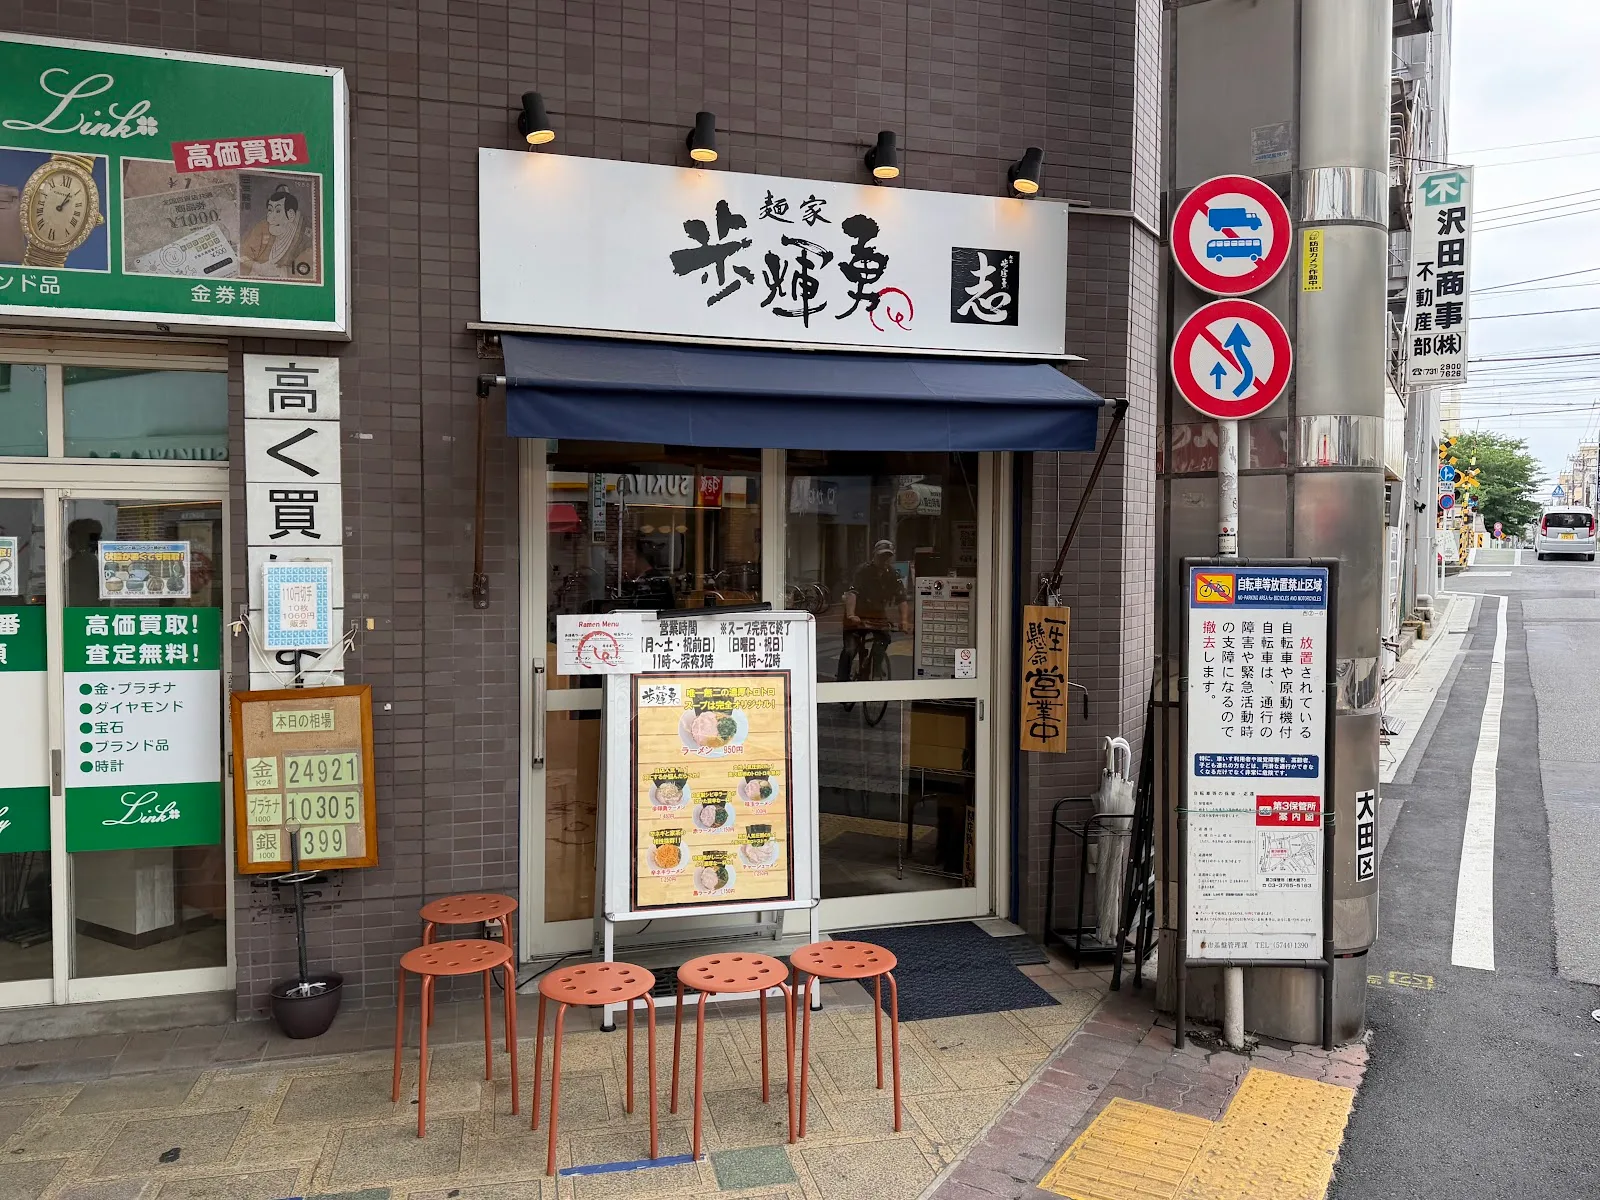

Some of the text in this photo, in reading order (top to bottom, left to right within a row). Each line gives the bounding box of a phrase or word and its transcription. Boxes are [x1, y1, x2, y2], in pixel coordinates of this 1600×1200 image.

[2, 68, 152, 139] Link
[183, 138, 297, 169] 高価買取
[758, 190, 832, 227] 麺家
[190, 284, 260, 306] 金券類
[957, 252, 1011, 323] 志
[1413, 261, 1434, 357] 不動産部
[1238, 577, 1322, 592] 自転車等放置禁止区域
[85, 614, 198, 636] 高価買取!
[602, 620, 620, 628] Menu
[660, 620, 698, 636] 営業時間
[86, 643, 199, 665] 査定無料!
[1202, 620, 1217, 700] 撤去します。
[94, 682, 176, 695] 金・プラチナ
[1221, 621, 1235, 738] の支障になるので
[1240, 621, 1255, 738] 障害や緊急活動時
[1279, 622, 1294, 739] 自転車や原動機付
[1299, 636, 1313, 739] 放置されている
[95, 701, 184, 714] ダイヤモンド
[1025, 665, 1064, 743] 営業中
[95, 721, 124, 734] 宝石
[276, 713, 331, 729] 本日の相場
[95, 739, 169, 753] ブランド品
[682, 746, 713, 755] ラーメン
[95, 760, 124, 773] 時計
[251, 758, 354, 783] 金 24921
[102, 791, 174, 826] Link
[250, 796, 355, 820] プラチナ 10305
[1273, 801, 1316, 811] 第3保管所
[256, 829, 342, 854] 銀 399
[1357, 792, 1374, 881] 大田区
[1200, 941, 1249, 949] 市基盤管理課
